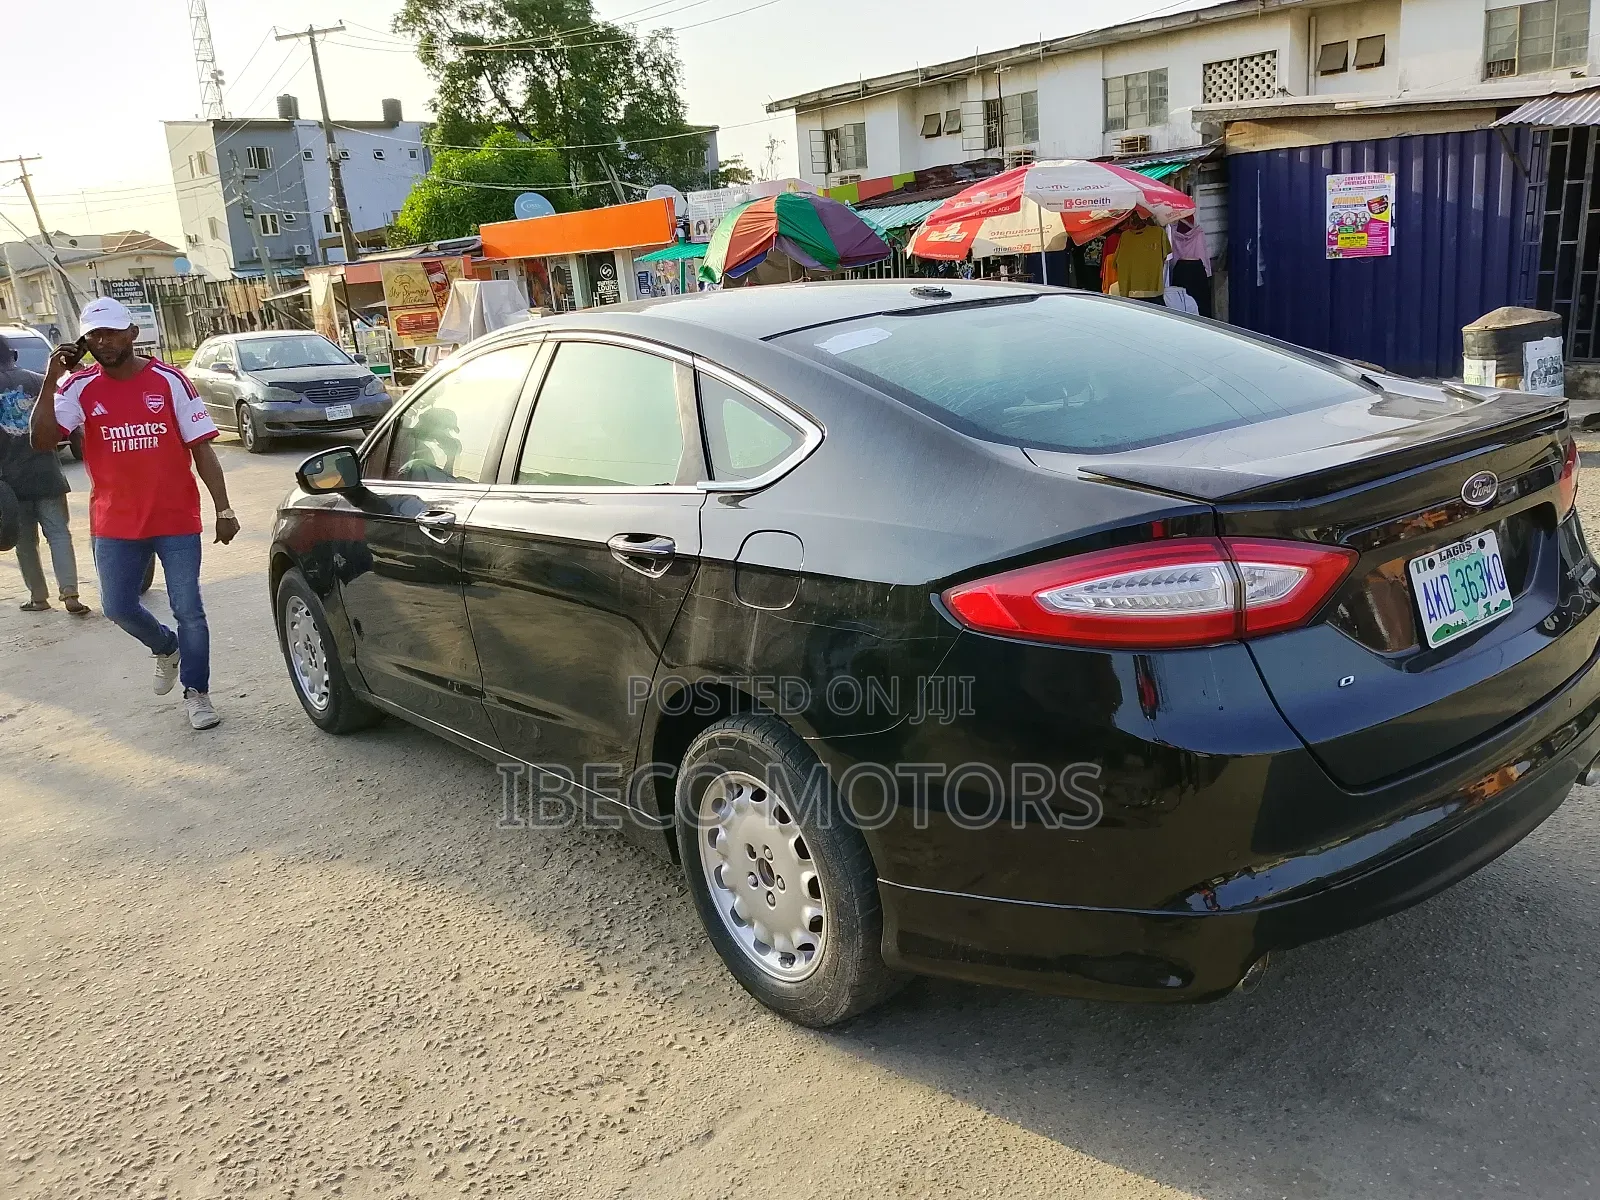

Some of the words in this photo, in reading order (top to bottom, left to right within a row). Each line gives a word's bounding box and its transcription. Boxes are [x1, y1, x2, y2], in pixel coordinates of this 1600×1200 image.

[1074, 197, 1111, 206] Geneith
[113, 290, 144, 298] ALLOWED
[100, 421, 168, 441] Emirates
[112, 439, 127, 453] FLY
[128, 436, 159, 451] BETTER
[1438, 540, 1473, 562] LAGOS
